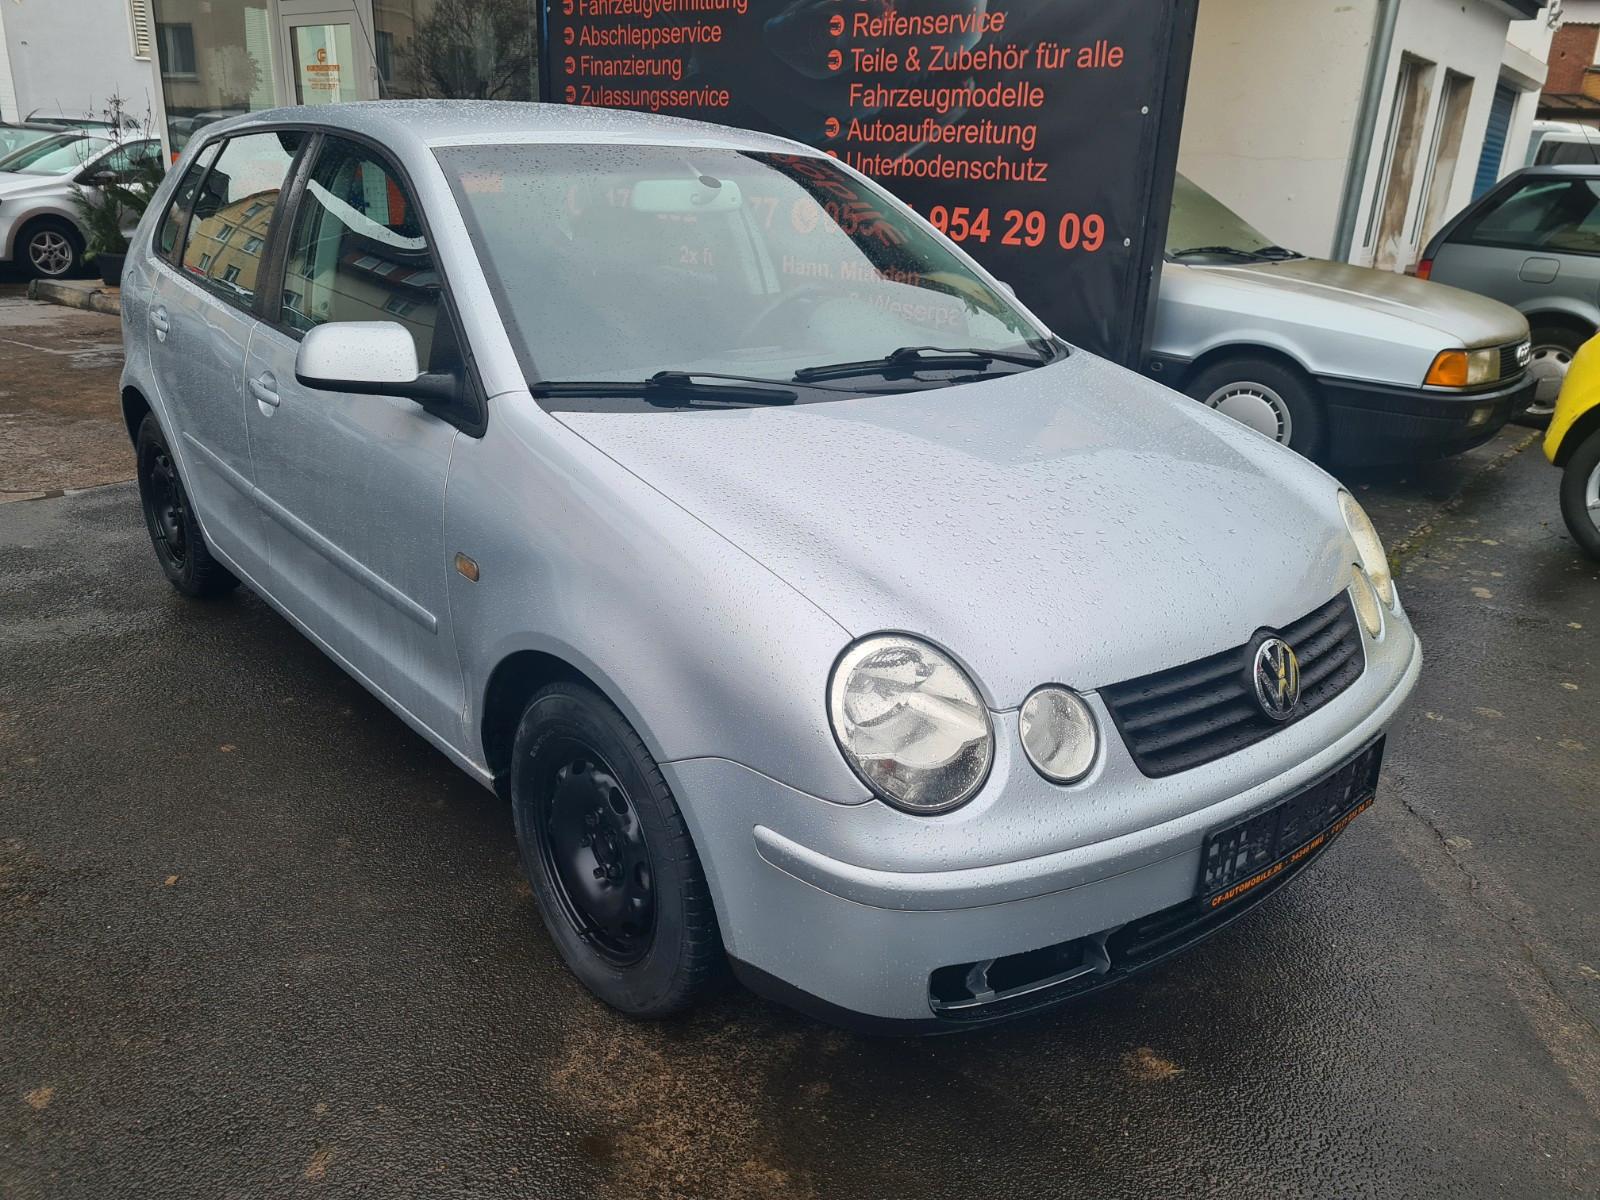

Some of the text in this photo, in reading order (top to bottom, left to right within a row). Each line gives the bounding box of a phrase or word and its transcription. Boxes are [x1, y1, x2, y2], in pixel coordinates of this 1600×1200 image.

[579, 20, 722, 49] Abschleppservice
[853, 7, 1006, 38] Reifenservice
[580, 54, 683, 80] Finanzierung
[851, 40, 1124, 73] Teile & Zubehör für alle
[581, 85, 730, 111] Zulassungsservice
[849, 81, 1045, 113] Fahrzeugmodelle
[847, 117, 1037, 150] Autoaufbereitung
[929, 205, 991, 243] 954
[1001, 209, 1046, 247] 29
[1058, 212, 1105, 252] 09
